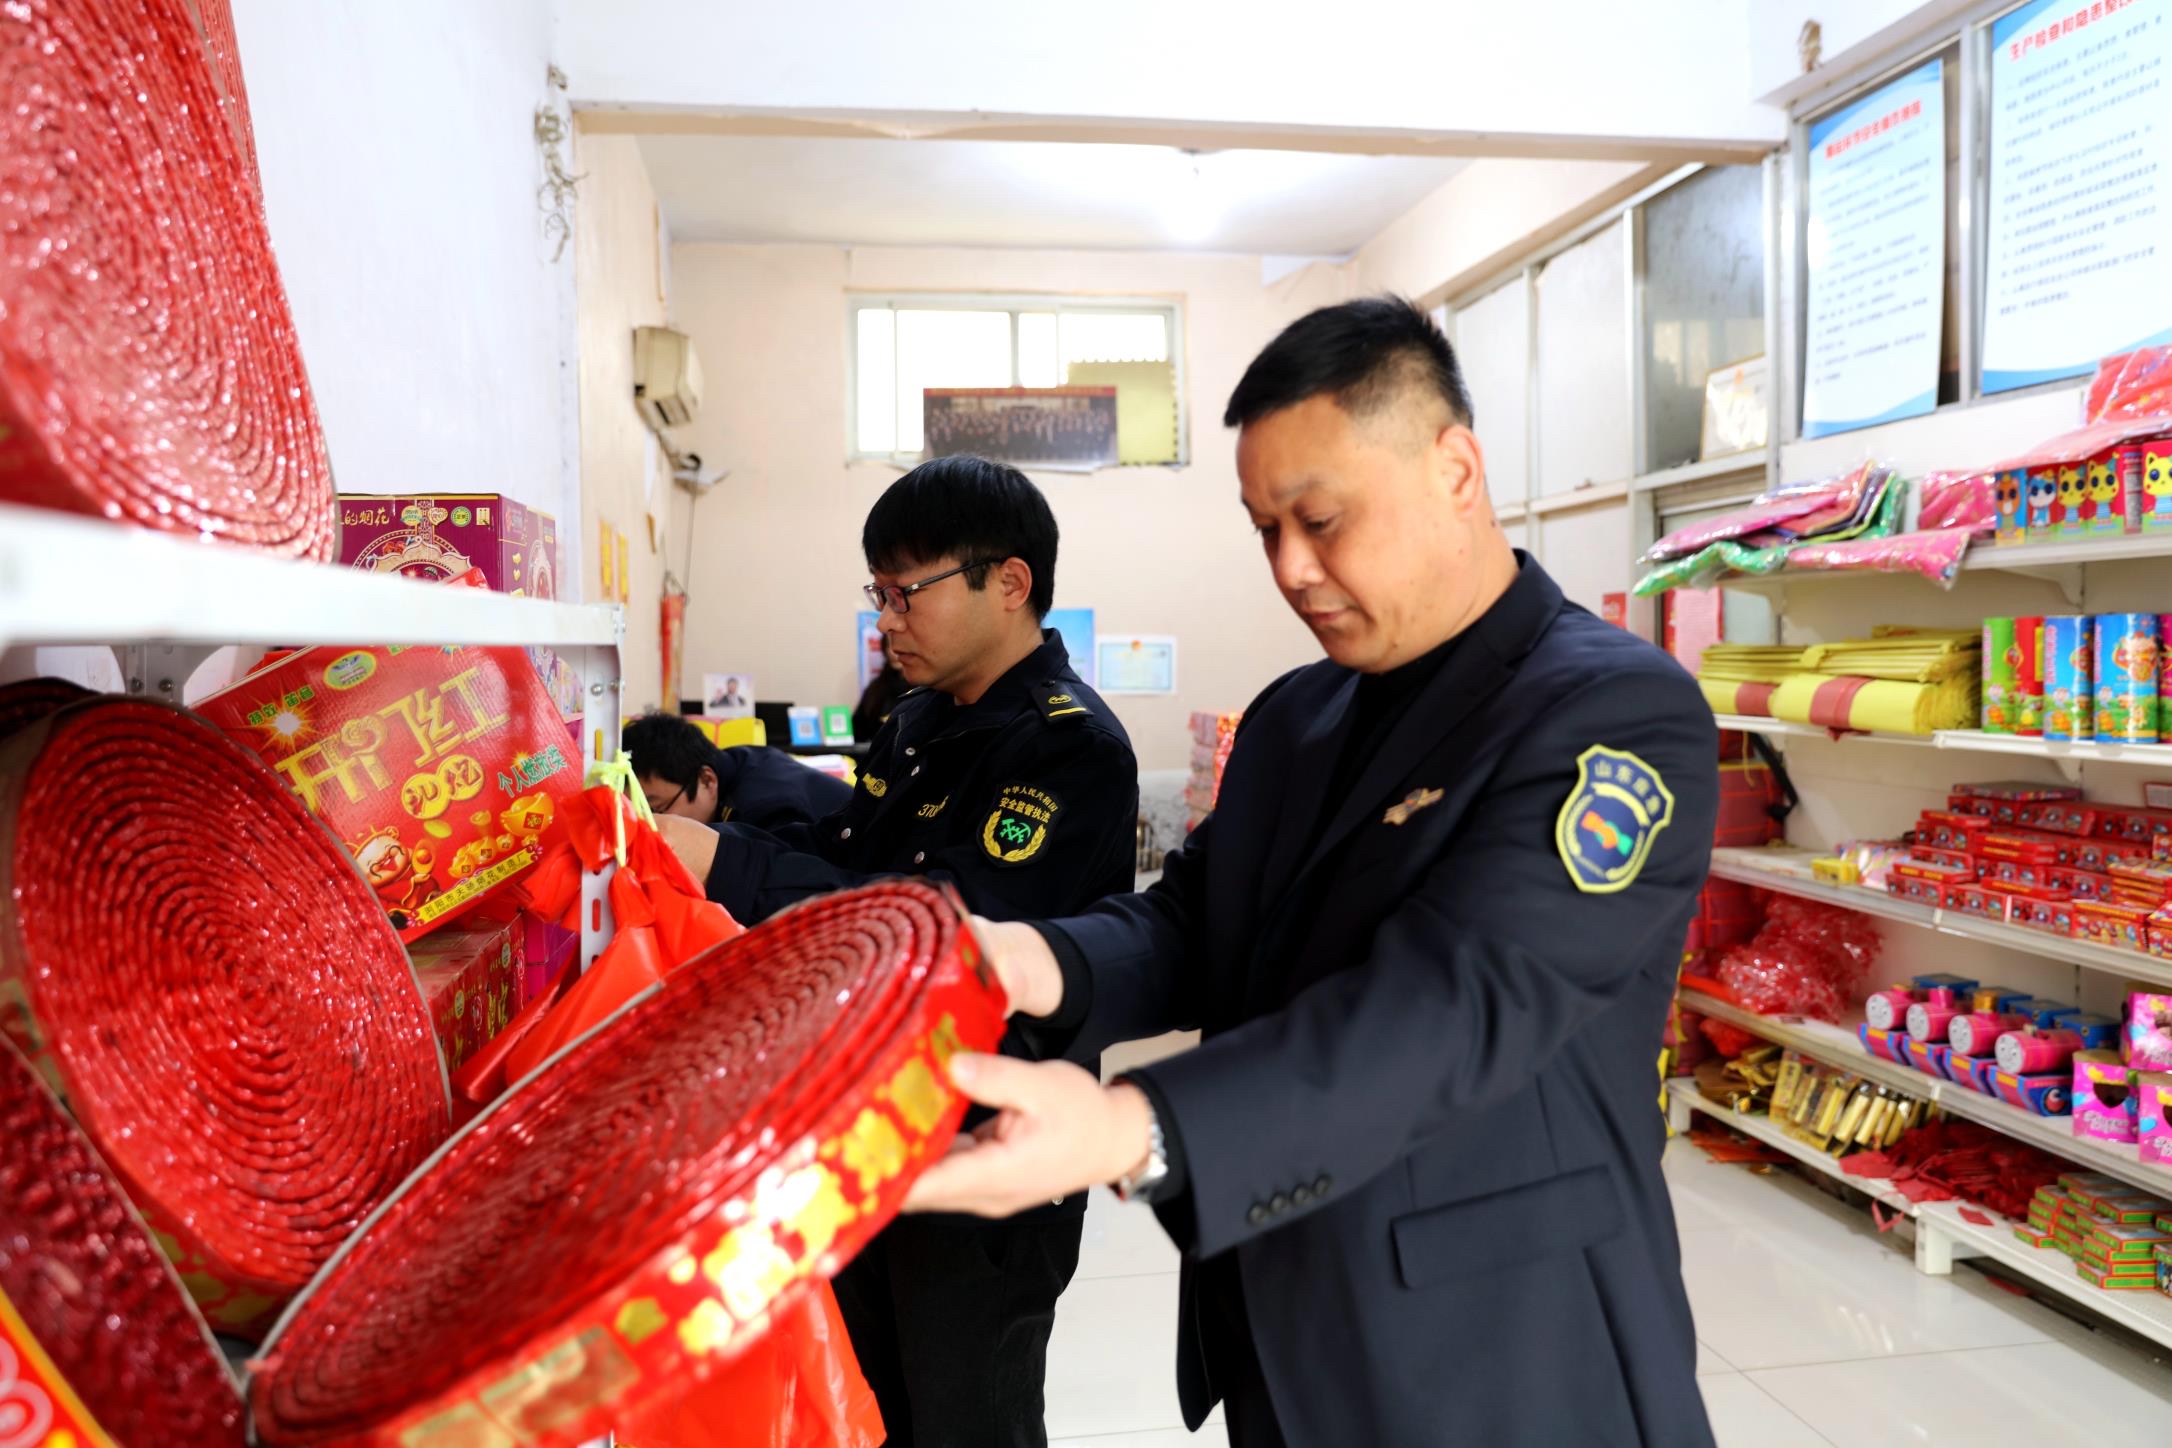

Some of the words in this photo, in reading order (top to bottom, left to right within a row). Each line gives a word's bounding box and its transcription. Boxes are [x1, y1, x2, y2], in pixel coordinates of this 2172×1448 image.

[1003, 785, 1058, 812] 中华人民共和国
